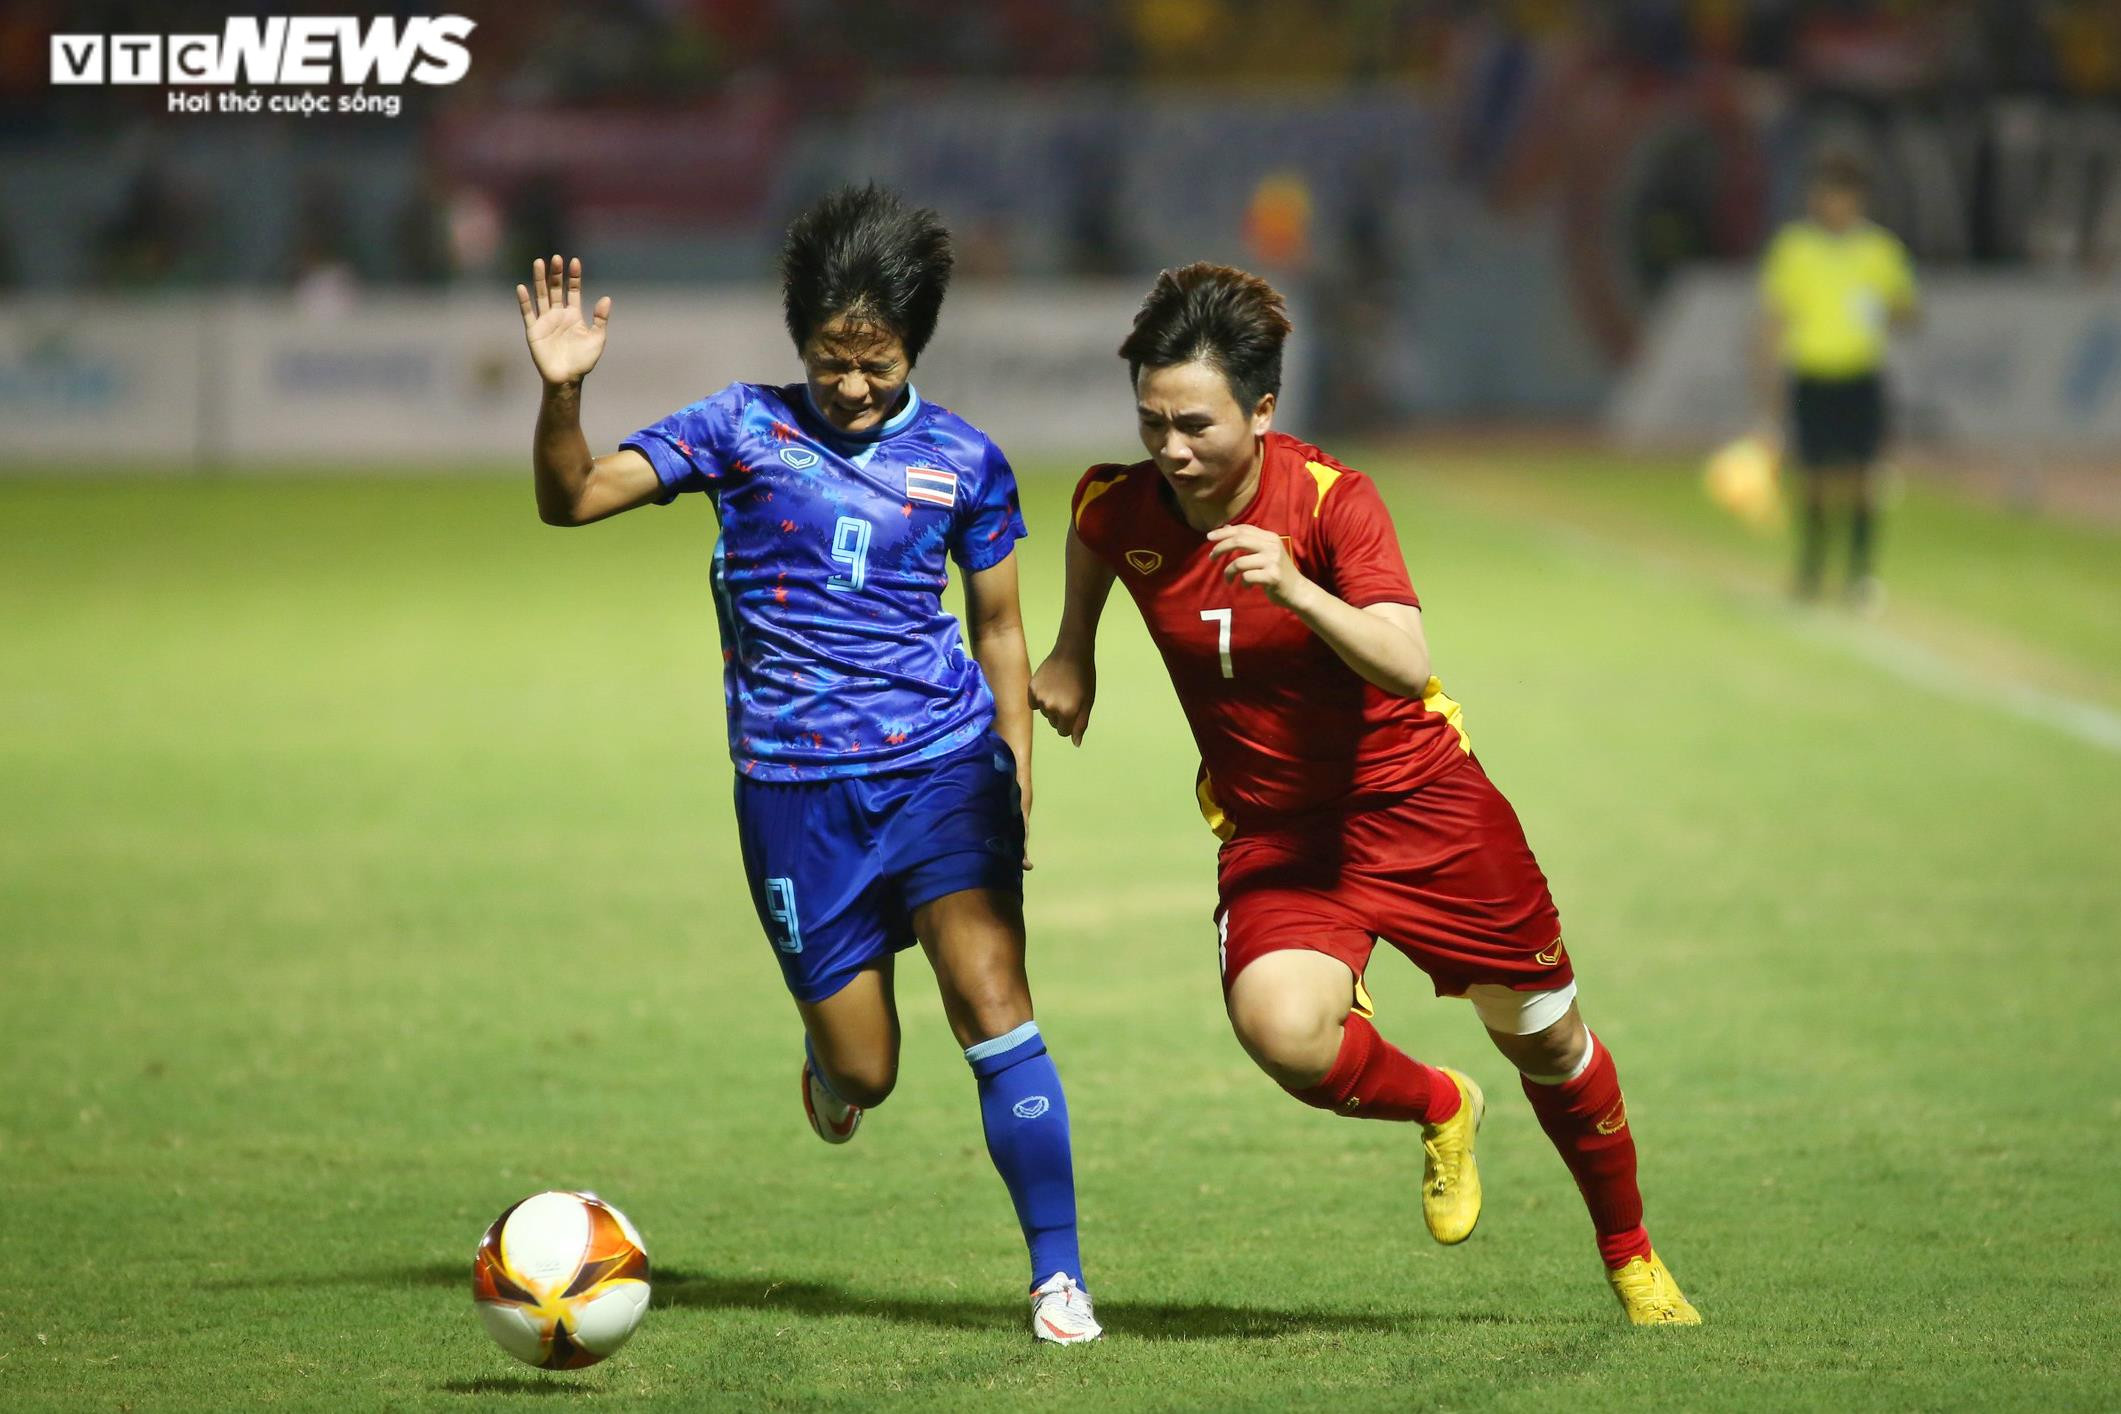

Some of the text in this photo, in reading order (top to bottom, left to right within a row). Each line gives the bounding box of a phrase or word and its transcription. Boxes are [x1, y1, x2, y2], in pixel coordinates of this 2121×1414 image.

[827, 515, 872, 592] 9
[1200, 608, 1234, 678] 7
[765, 877, 803, 953] 9
